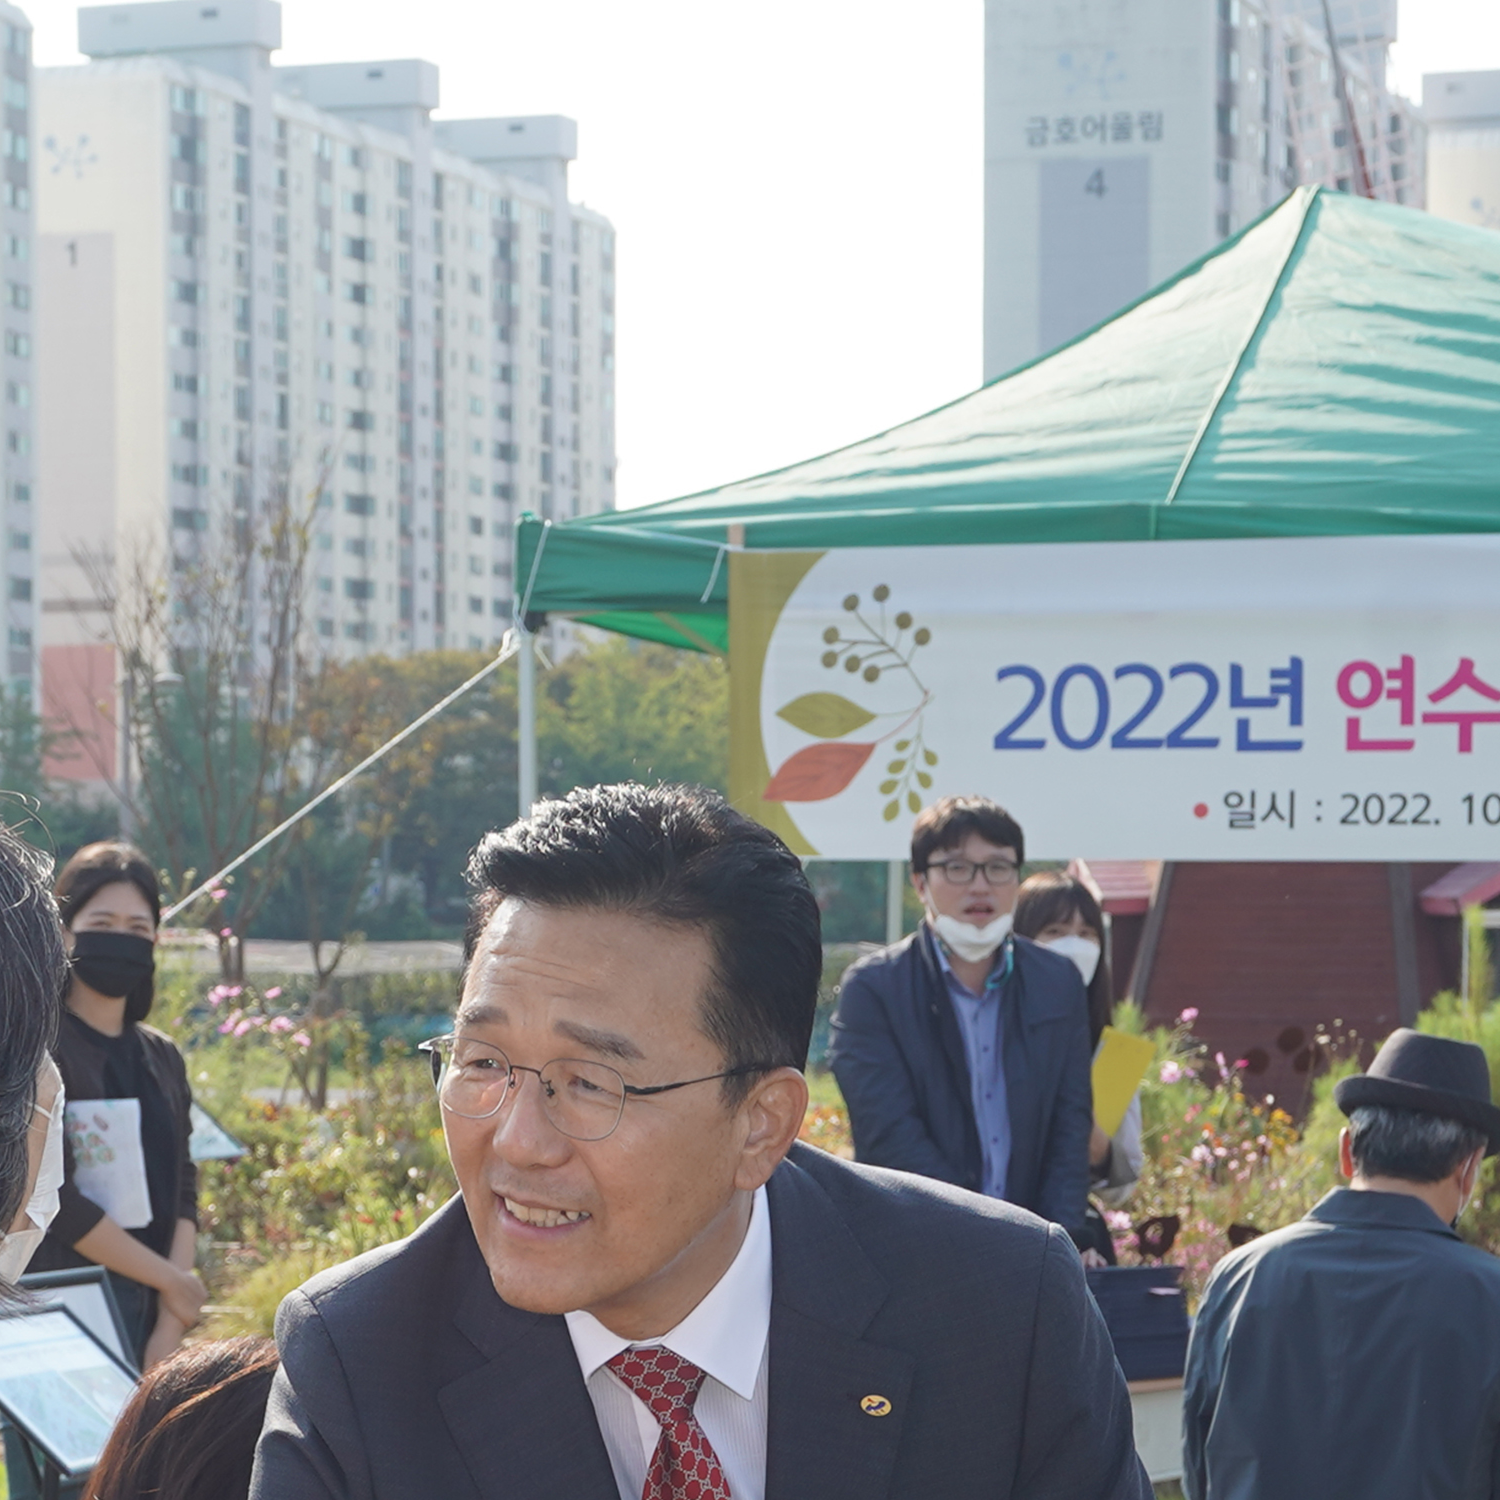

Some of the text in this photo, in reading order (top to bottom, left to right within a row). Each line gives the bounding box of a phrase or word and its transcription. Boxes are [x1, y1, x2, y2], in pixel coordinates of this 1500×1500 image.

[1025, 111, 1164, 147] 금호어울림
[1084, 167, 1109, 198] 4
[64, 239, 78, 268] 1
[992, 655, 1303, 753] 2022년
[1223, 789, 1295, 829] 일시
[1339, 793, 1441, 826] 2022.
